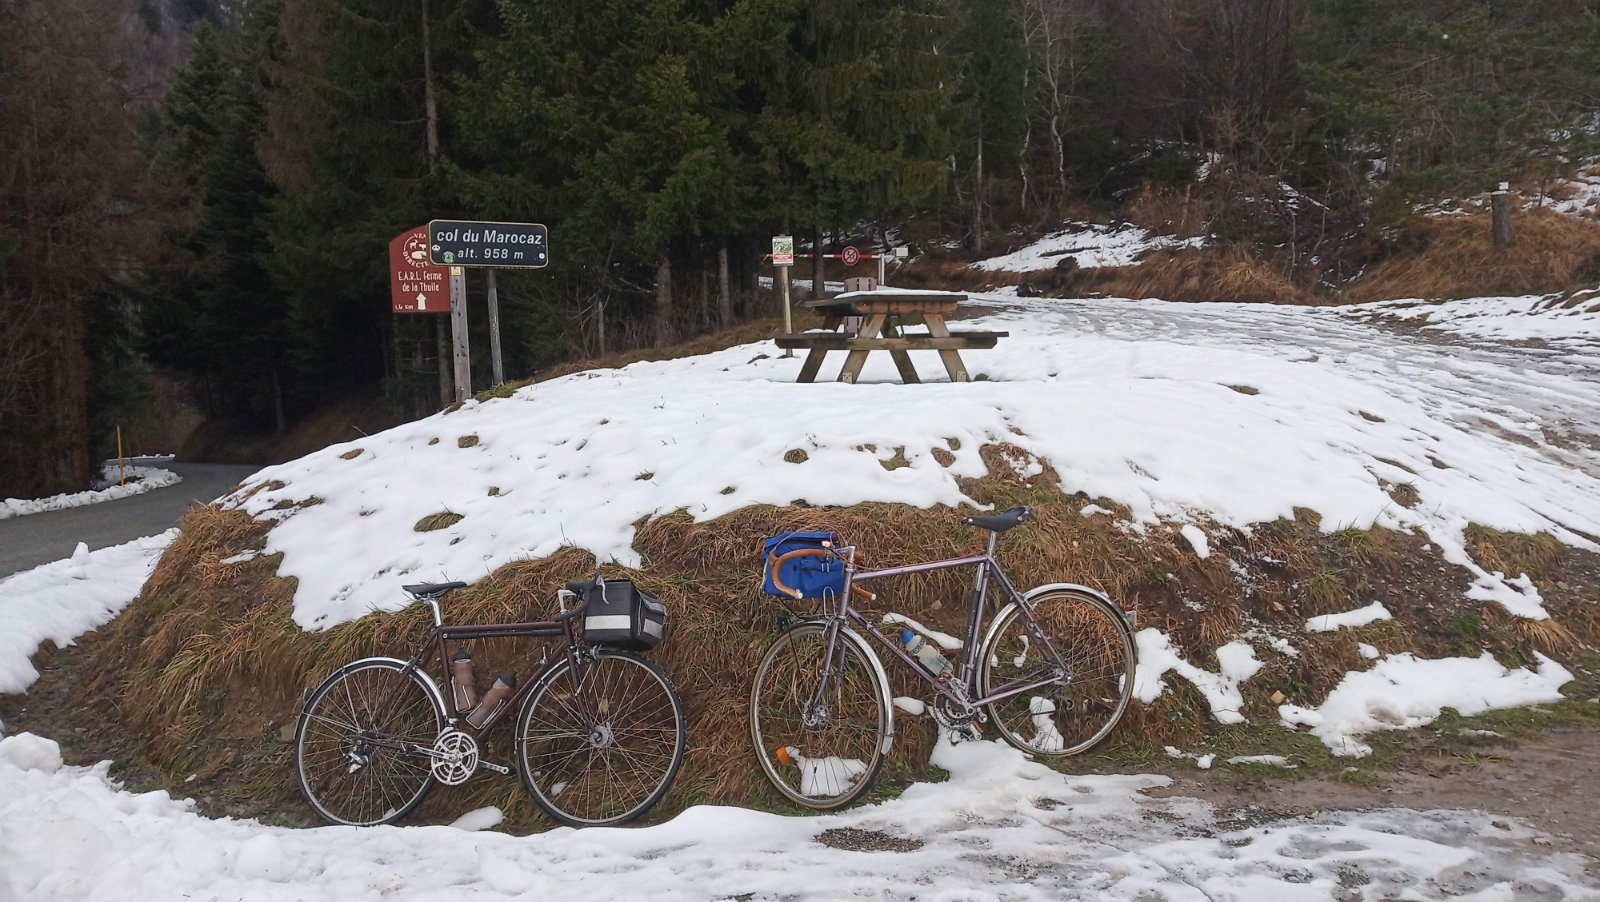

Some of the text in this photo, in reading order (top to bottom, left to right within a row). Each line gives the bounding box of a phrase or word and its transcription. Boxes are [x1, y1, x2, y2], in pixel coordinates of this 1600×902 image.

[437, 229, 542, 245] col du Marocaz
[458, 248, 478, 259] alt.
[484, 249, 508, 259] 958
[514, 251, 524, 260] m
[398, 271, 442, 281] E.A.R.L. Ferme
[402, 282, 410, 292] de
[411, 282, 418, 292] la
